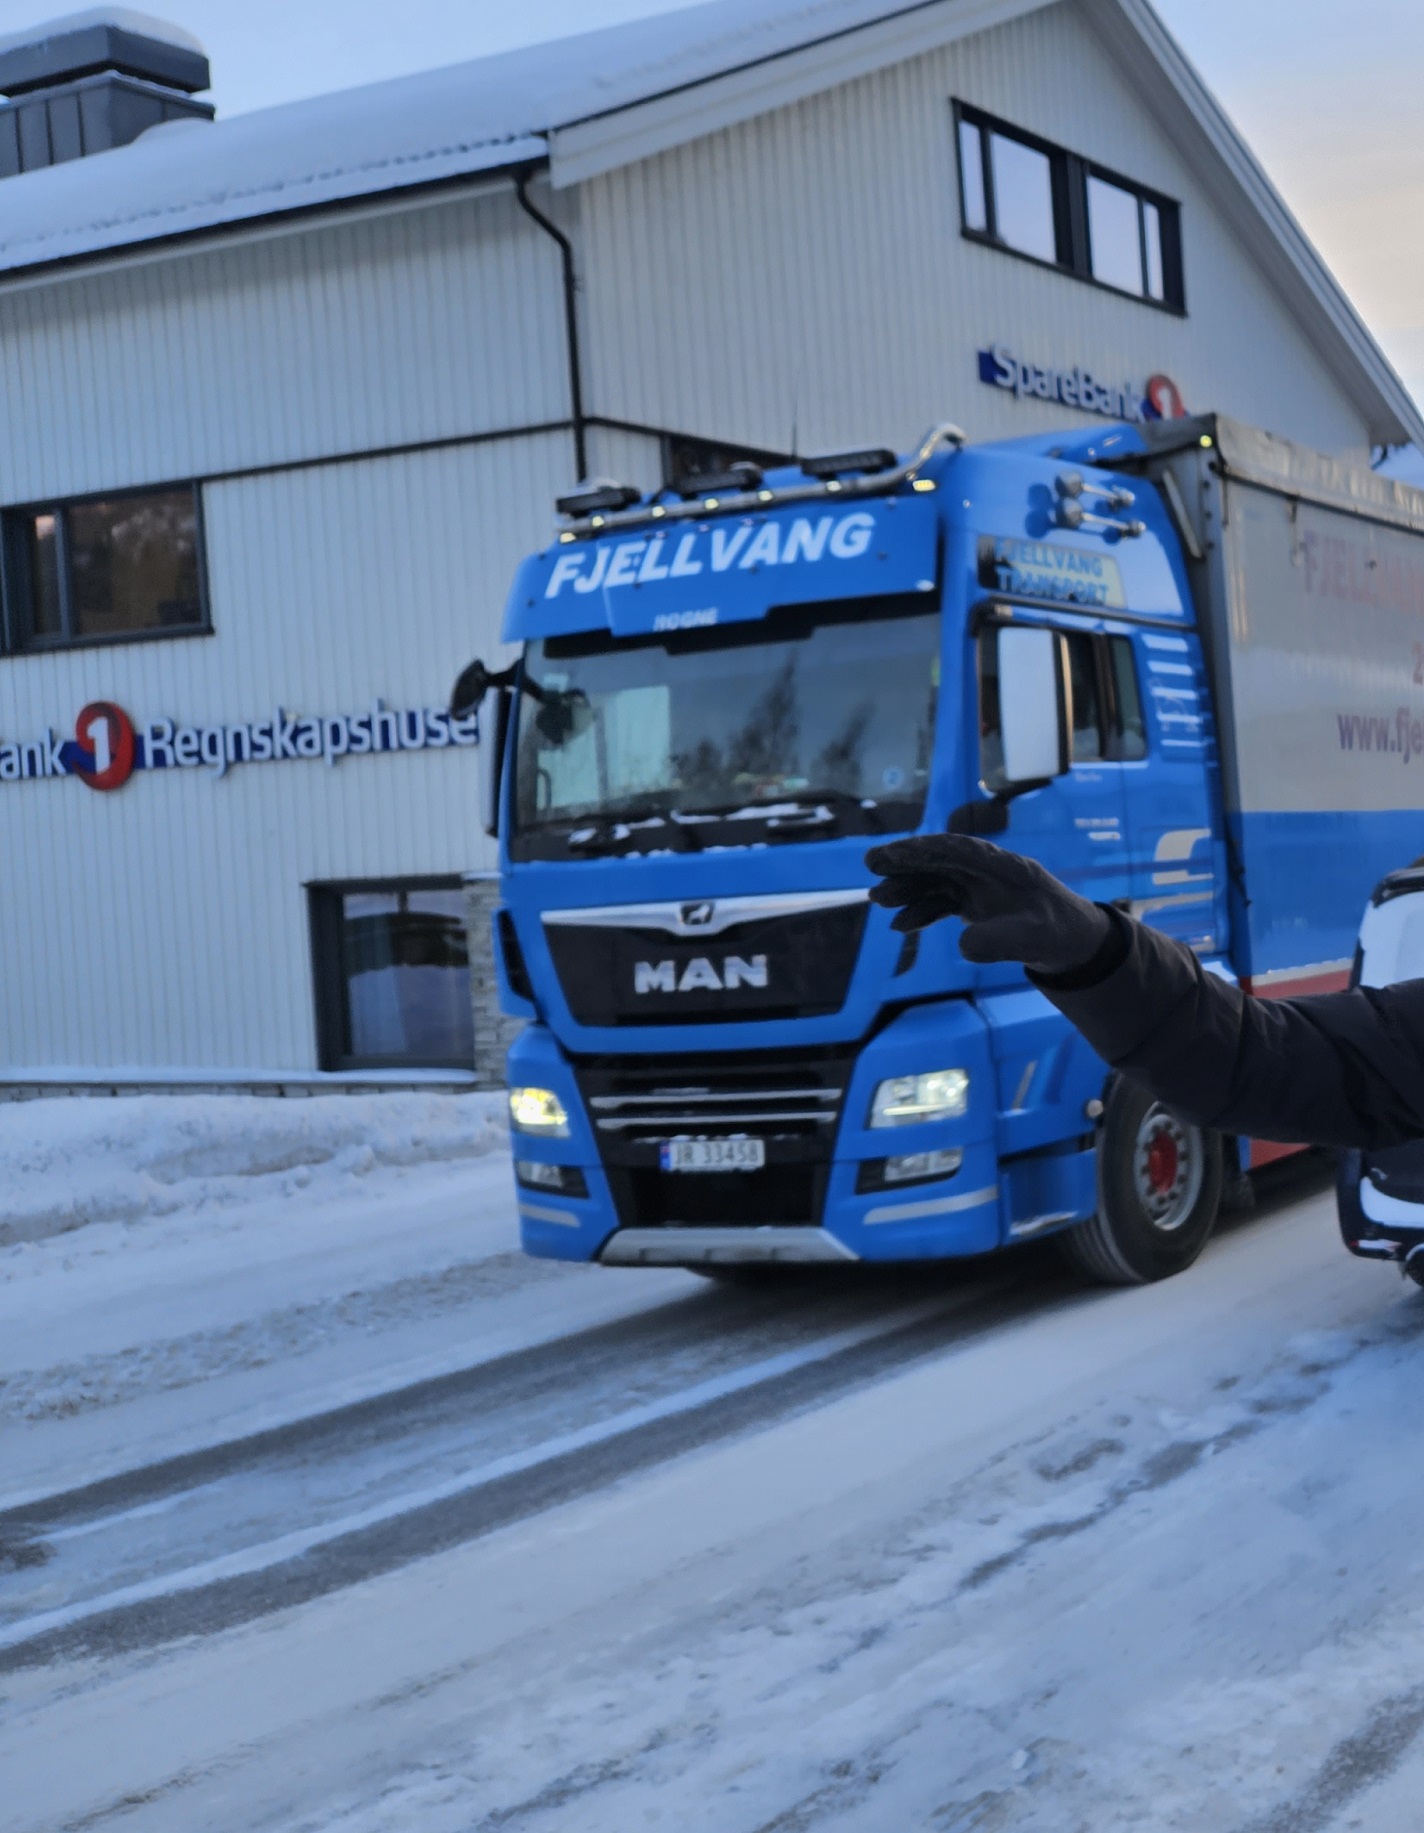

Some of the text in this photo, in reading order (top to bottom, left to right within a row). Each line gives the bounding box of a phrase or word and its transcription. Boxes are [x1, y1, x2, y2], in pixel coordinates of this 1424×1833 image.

[990, 343, 1146, 424] SpareBank
[544, 512, 875, 599] FJELLVANG
[995, 537, 1104, 578] FJELLVANG
[997, 565, 1109, 604] TRANSPORT
[653, 606, 718, 632] ROGNE
[634, 954, 767, 993] MAN
